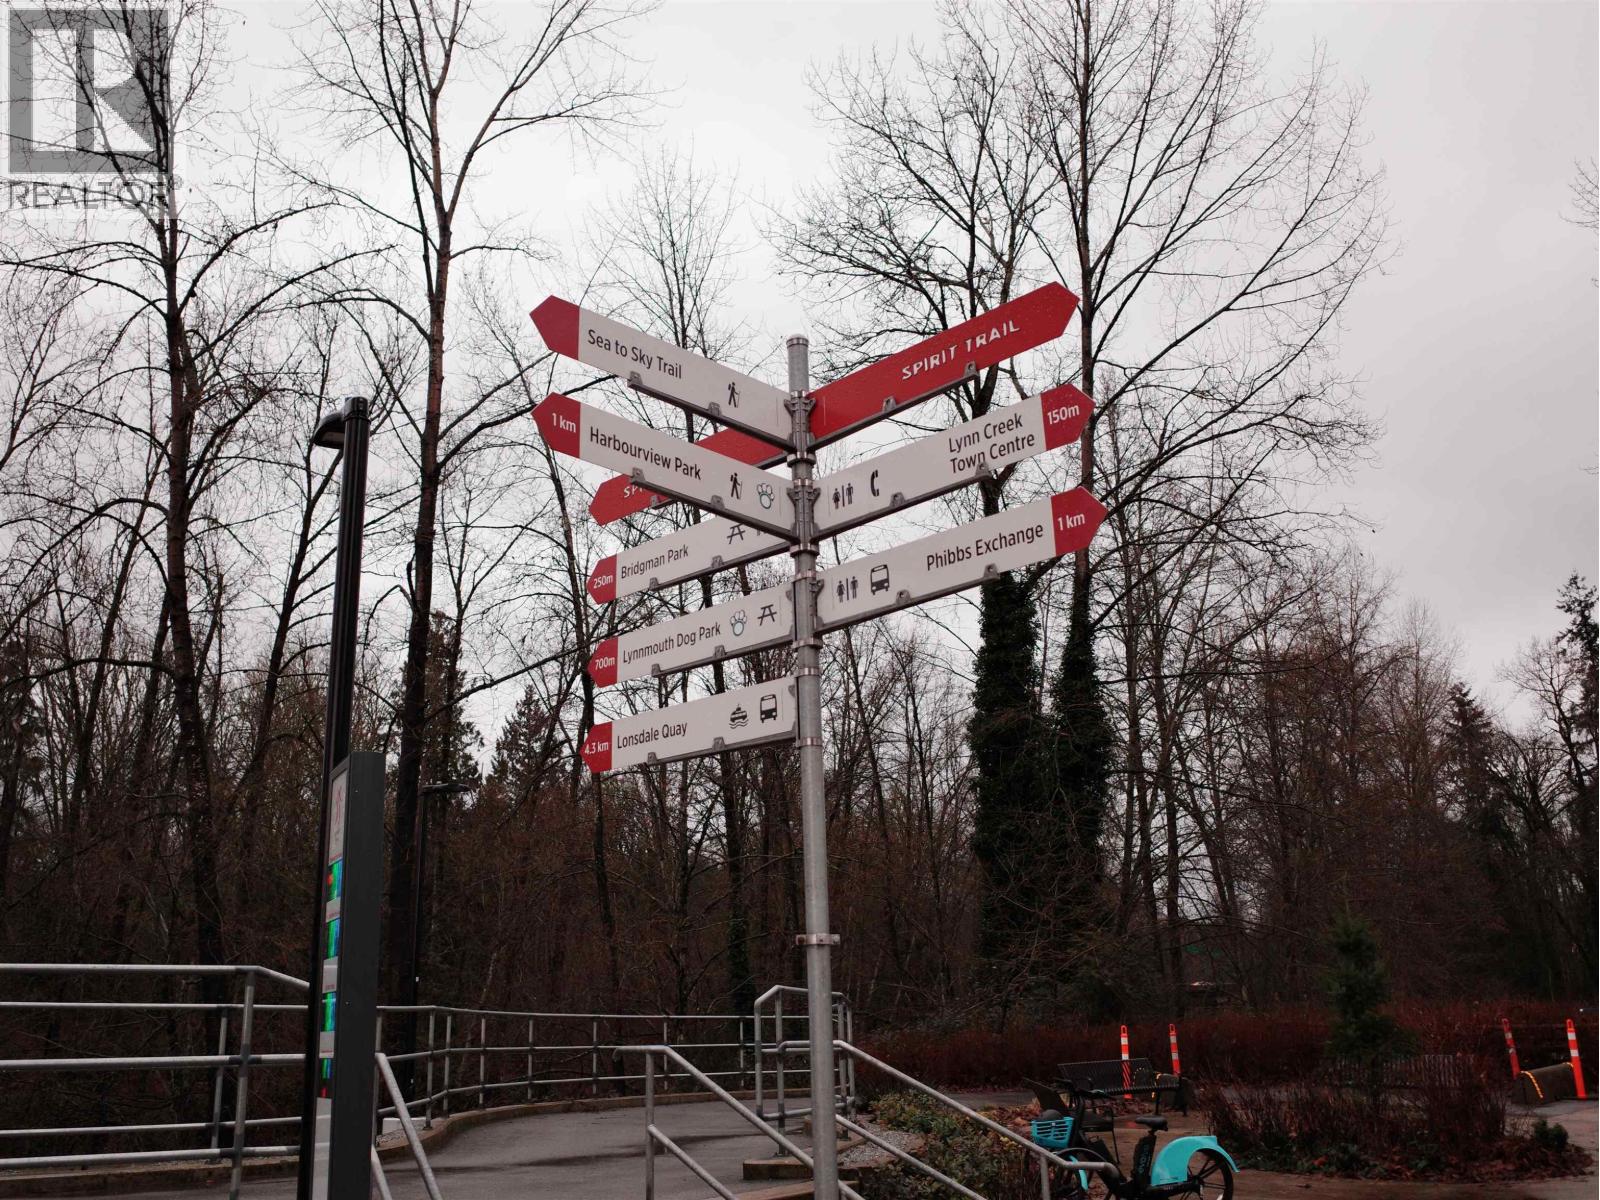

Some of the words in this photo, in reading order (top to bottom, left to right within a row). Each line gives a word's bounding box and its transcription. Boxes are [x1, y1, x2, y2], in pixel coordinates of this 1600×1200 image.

[588, 329, 611, 351] Sea
[616, 340, 627, 358] to
[631, 347, 654, 370] Sky
[657, 356, 682, 379] Trail
[902, 345, 958, 380] SPIRIT
[966, 320, 1020, 352] TRAIL
[948, 432, 980, 455] Lynn
[984, 413, 1024, 440] Creek
[1047, 404, 1080, 426] 150m
[552, 412, 558, 426] 1
[559, 413, 576, 433] km
[590, 426, 672, 470] Harbourview
[675, 457, 702, 480] Park
[950, 450, 986, 474] Town
[990, 433, 1035, 460] Centre
[926, 540, 972, 570] Phibbs
[976, 524, 1044, 557] Exchange
[1058, 515, 1064, 532] 1
[1066, 512, 1086, 530] km
[593, 574, 614, 589] 250m
[621, 556, 666, 579] Bridgman
[668, 544, 689, 562] Park
[595, 657, 615, 671] 700m
[623, 636, 674, 664] Lynnmouth
[677, 629, 696, 648] Dog
[700, 622, 721, 638] Park
[584, 742, 596, 755] 4.3
[597, 740, 608, 752] km
[617, 728, 659, 750] Lonsdale
[662, 722, 688, 739] Quay
